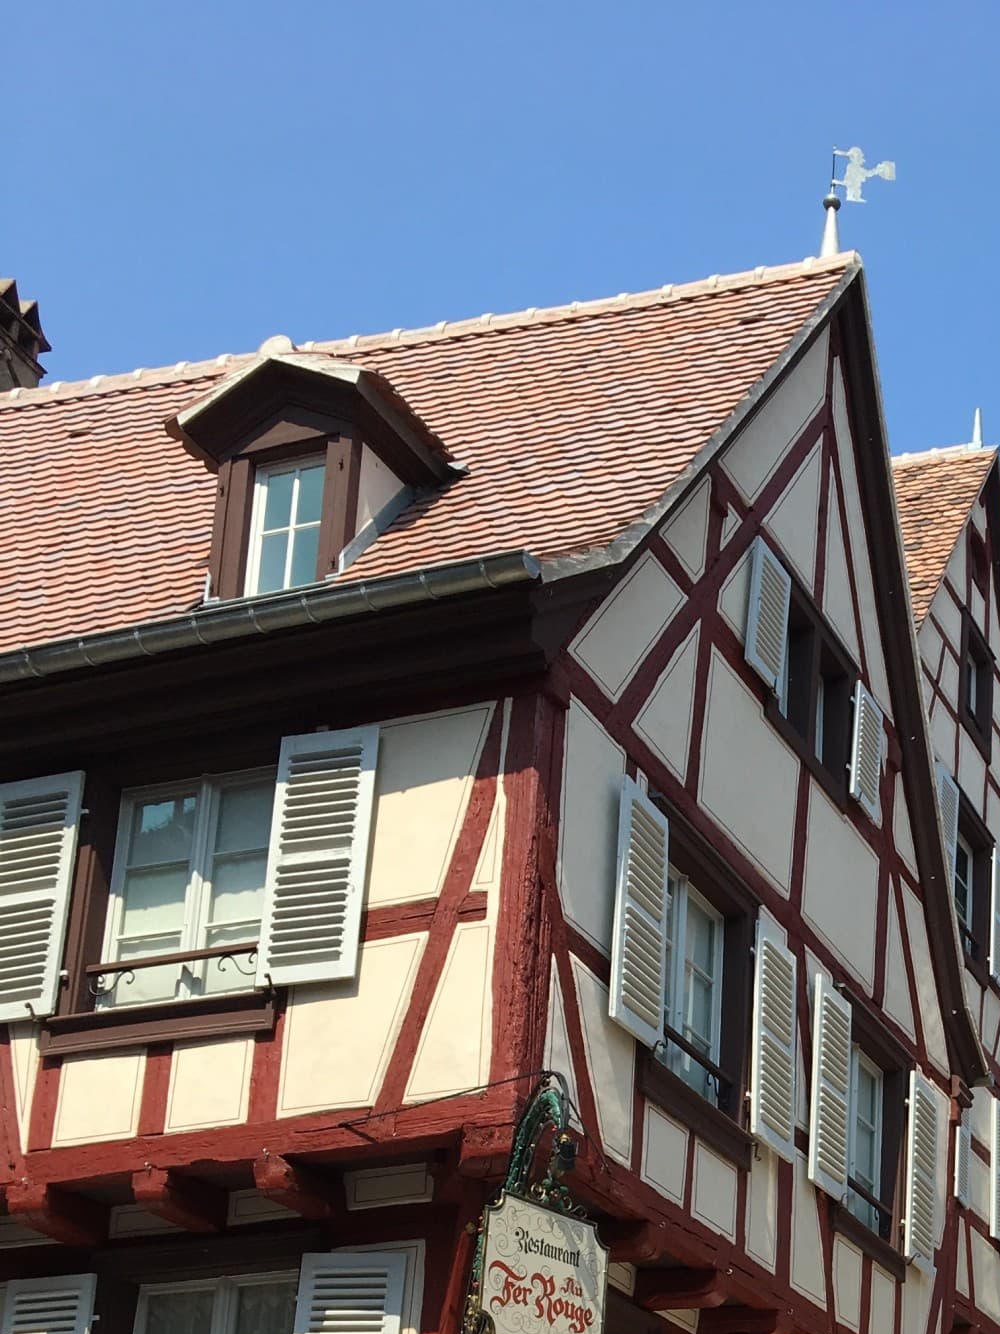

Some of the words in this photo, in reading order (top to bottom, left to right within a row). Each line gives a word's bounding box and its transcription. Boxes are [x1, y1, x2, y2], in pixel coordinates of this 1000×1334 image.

[515, 1226, 581, 1268] Restaurant
[488, 1260, 531, 1307] Fer
[531, 1273, 593, 1333] Rouge
[560, 1276, 583, 1298] Au
